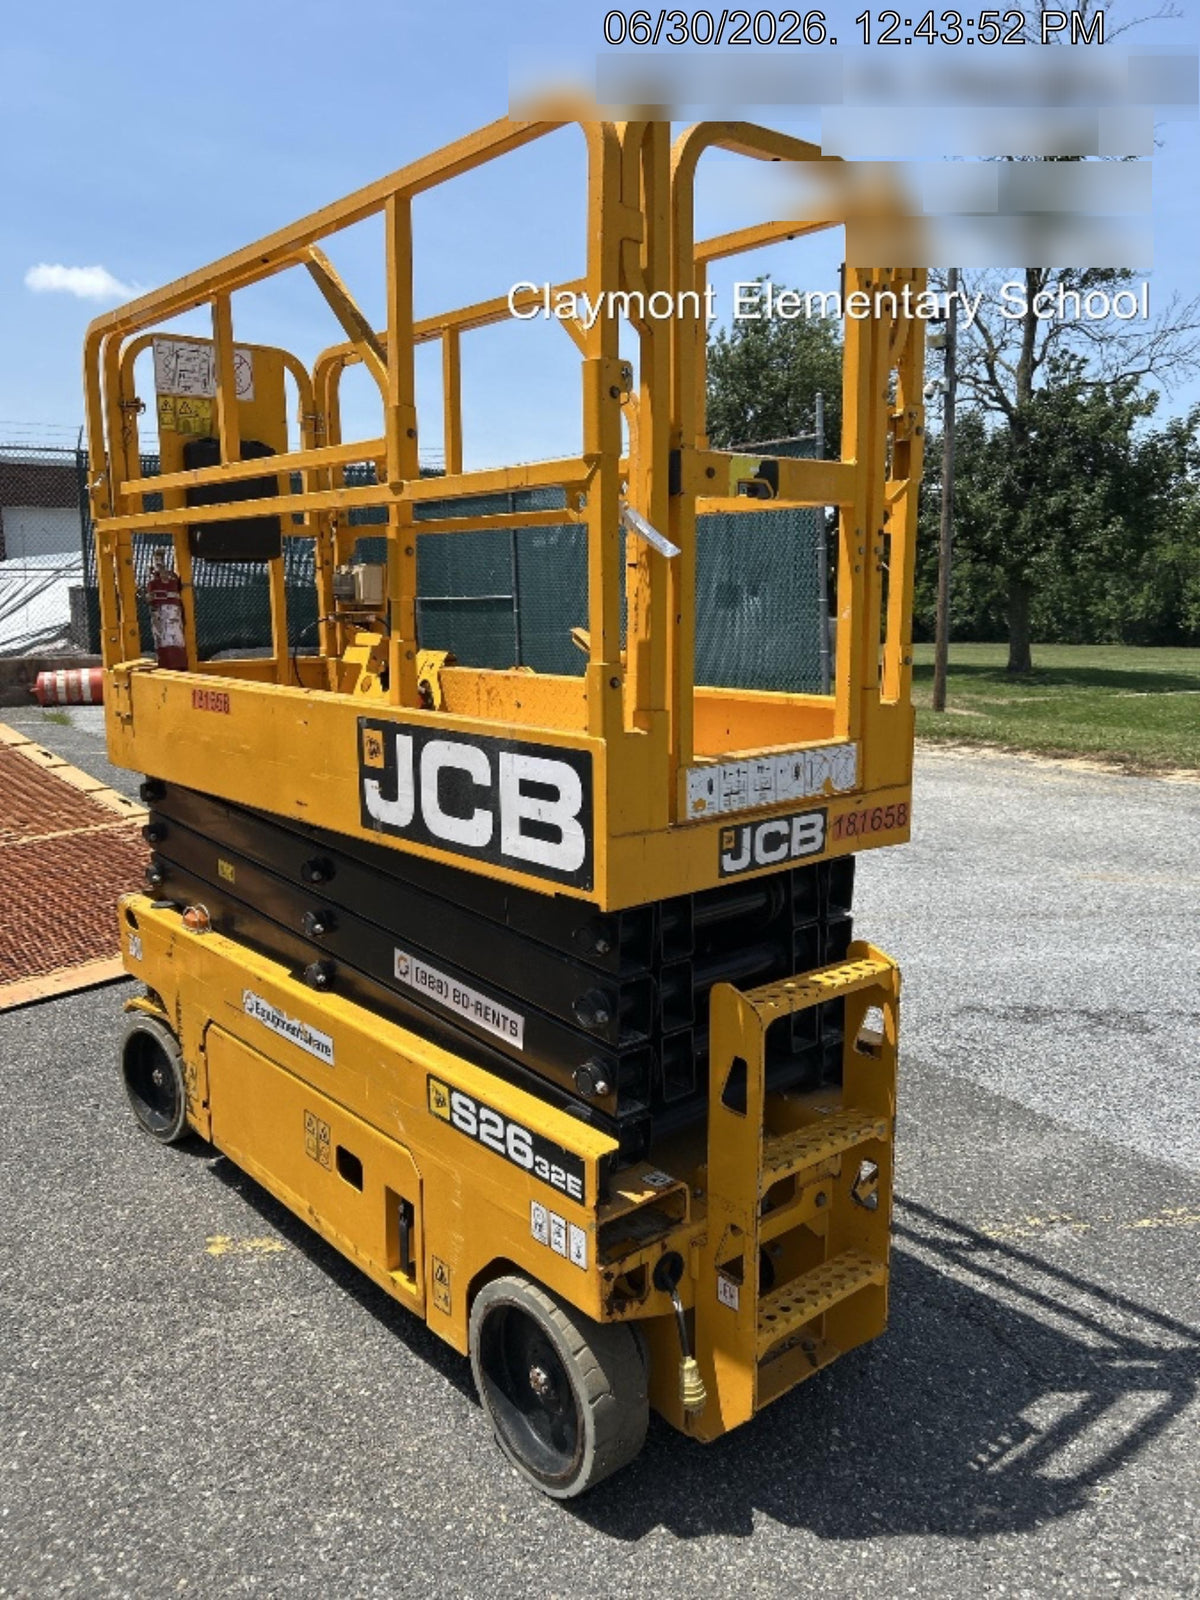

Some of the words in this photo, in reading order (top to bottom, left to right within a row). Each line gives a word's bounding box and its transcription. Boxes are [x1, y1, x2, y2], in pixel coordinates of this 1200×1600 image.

[364, 734, 586, 872] JCB
[834, 804, 908, 838] 181658
[722, 813, 825, 872] JCB
